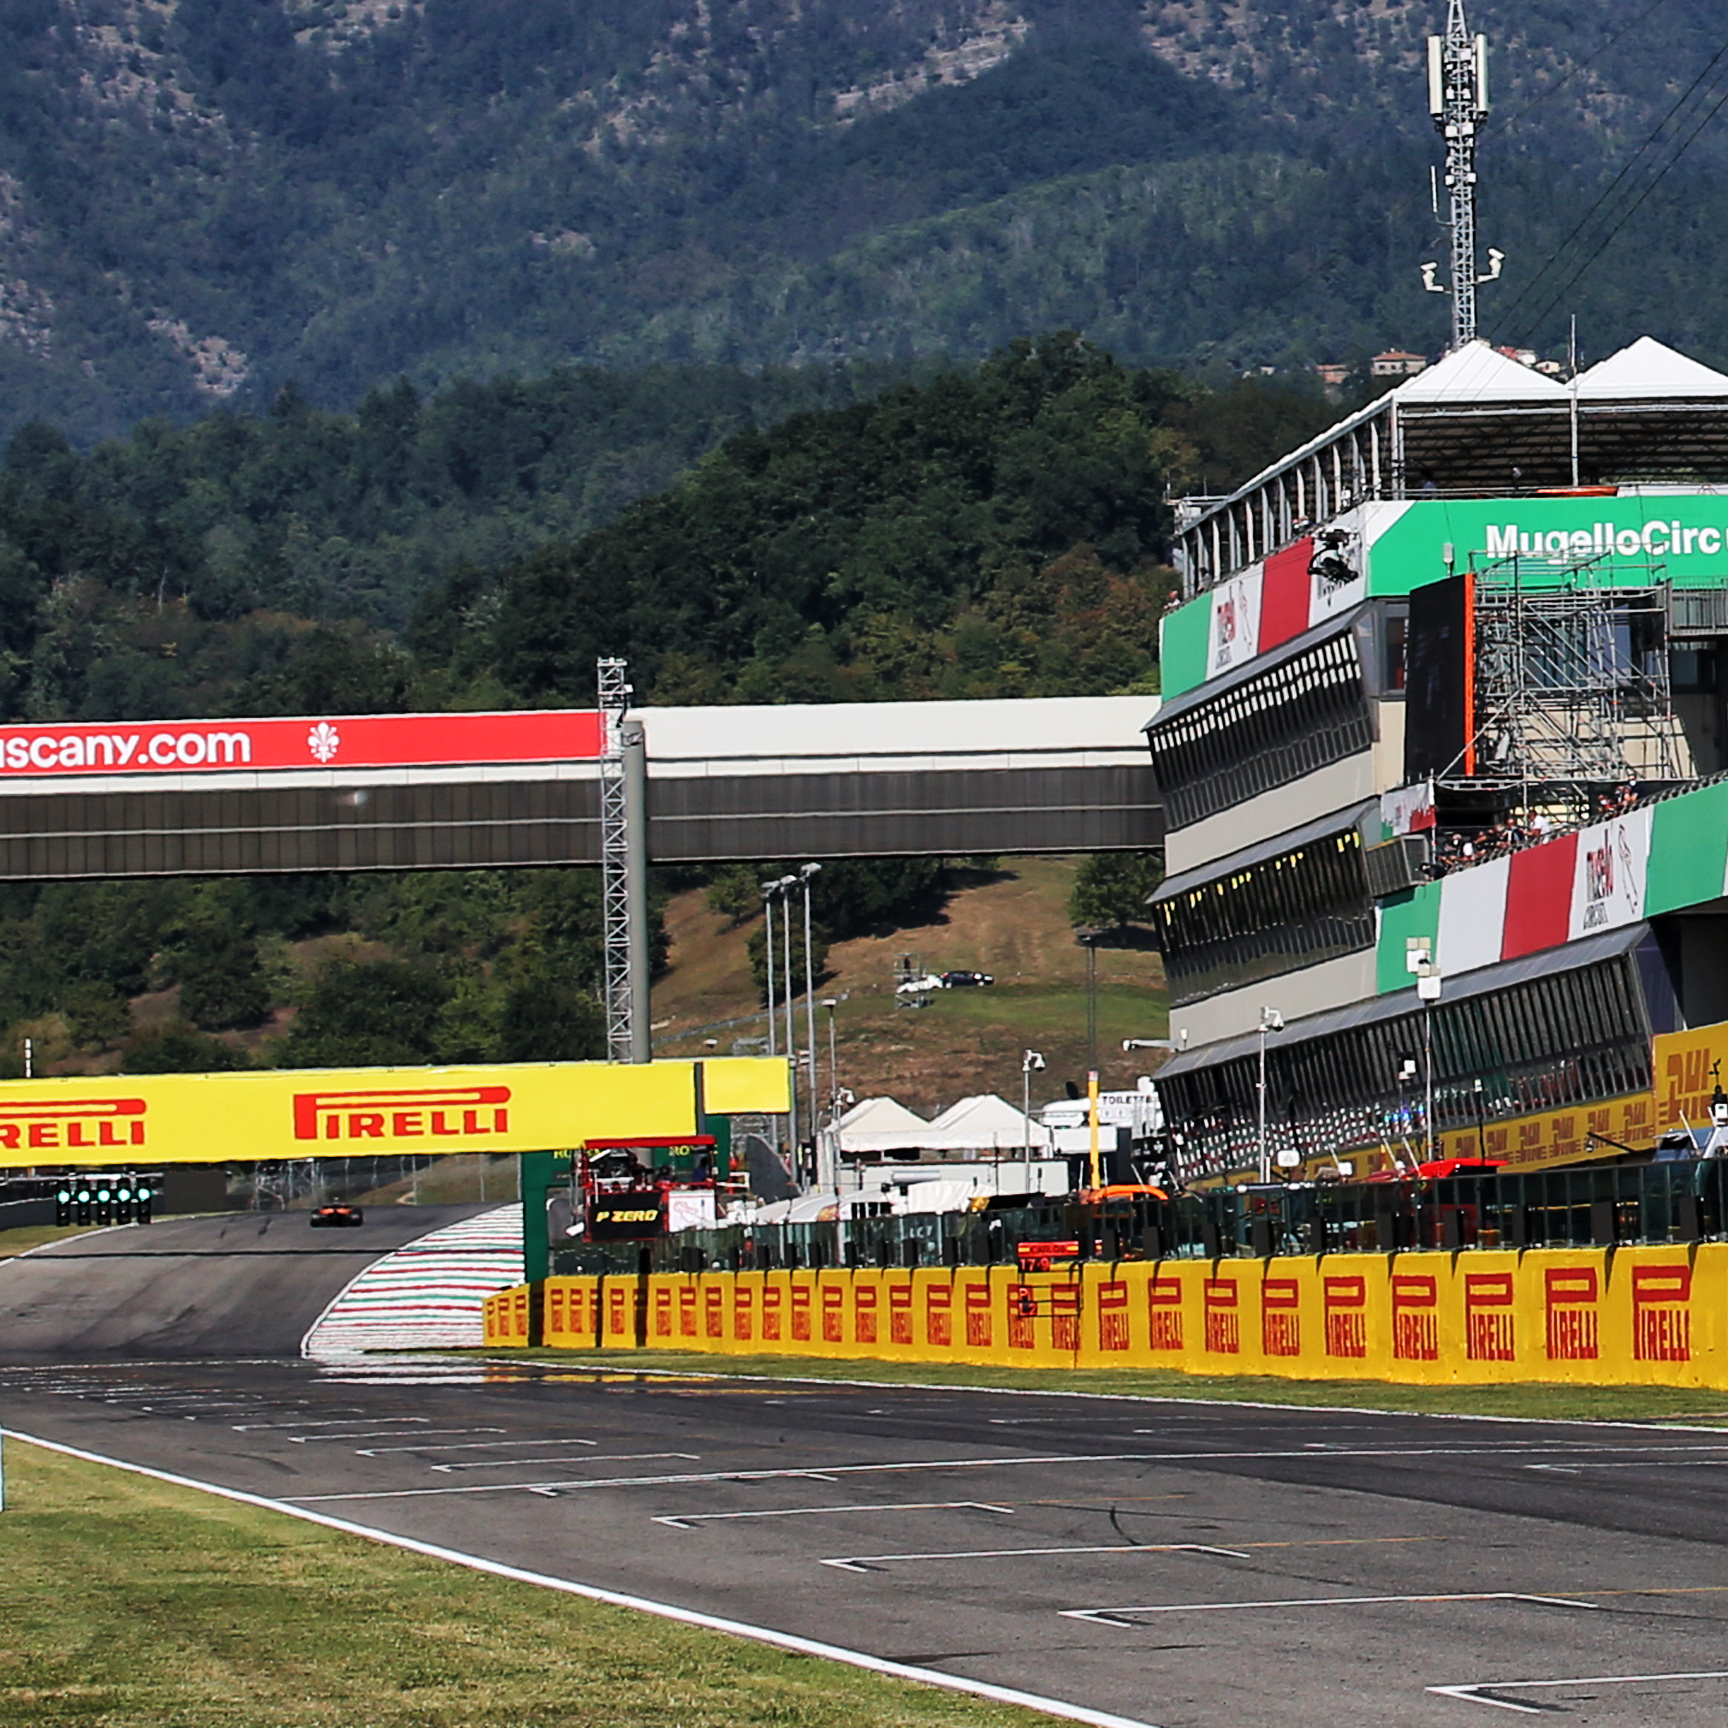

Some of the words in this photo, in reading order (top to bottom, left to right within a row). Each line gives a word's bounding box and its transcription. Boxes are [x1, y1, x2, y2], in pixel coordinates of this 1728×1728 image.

[0, 732, 251, 768] scany.com
[293, 1086, 512, 1140] PIRELLI
[1667, 1048, 1716, 1125] DHL
[596, 1211, 609, 1222] P
[611, 1209, 658, 1222] ZERO
[1261, 1279, 1300, 1356] PIRELLI
[1324, 1276, 1367, 1358] PIRELLI
[1392, 1275, 1438, 1361] PIRELLI
[1465, 1273, 1515, 1361] PIRELLI
[1545, 1267, 1599, 1361] PIRELLI
[1632, 1265, 1691, 1361] PIRELLI
